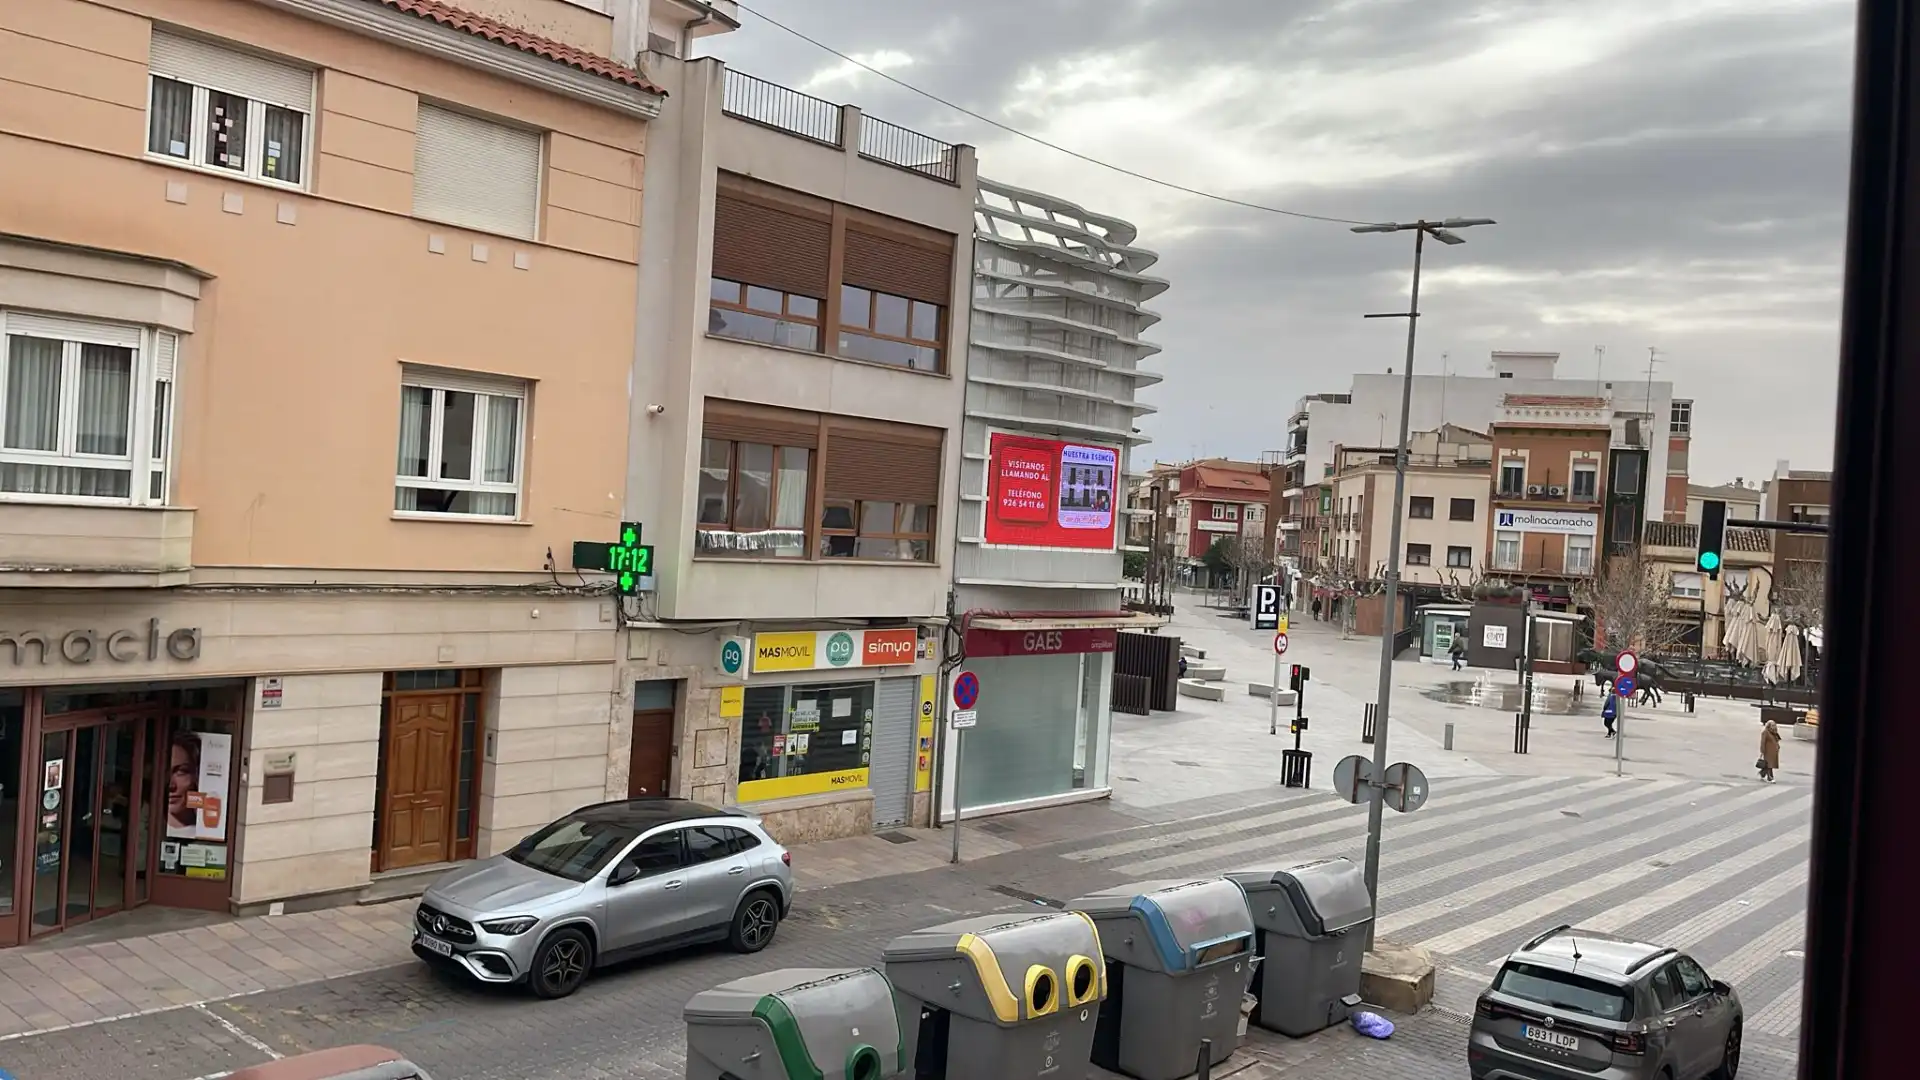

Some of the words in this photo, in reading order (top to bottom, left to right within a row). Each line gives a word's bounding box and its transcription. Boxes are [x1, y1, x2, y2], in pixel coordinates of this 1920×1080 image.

[1063, 450, 1090, 460] NUESTRA
[1091, 453, 1114, 463] ESENCIA
[1008, 460, 1045, 472] VISÍTANOS
[1001, 470, 1038, 480] LLAMANDO
[1008, 488, 1042, 499] TELÉFONO
[1003, 498, 1017, 508] 926
[1018, 499, 1027, 508] 54
[1514, 514, 1593, 528] molinacamacho
[609, 545, 648, 573] 17:12
[1261, 587, 1276, 613] P
[868, 638, 912, 657] simyo
[1023, 631, 1063, 651] GAES
[759, 645, 810, 659] MASMOVIL
[831, 641, 850, 656] pg
[725, 649, 739, 665] pg
[831, 774, 864, 785] MASMOVIL
[1527, 1027, 1553, 1042] 6831
[1556, 1033, 1576, 1047] LDP
